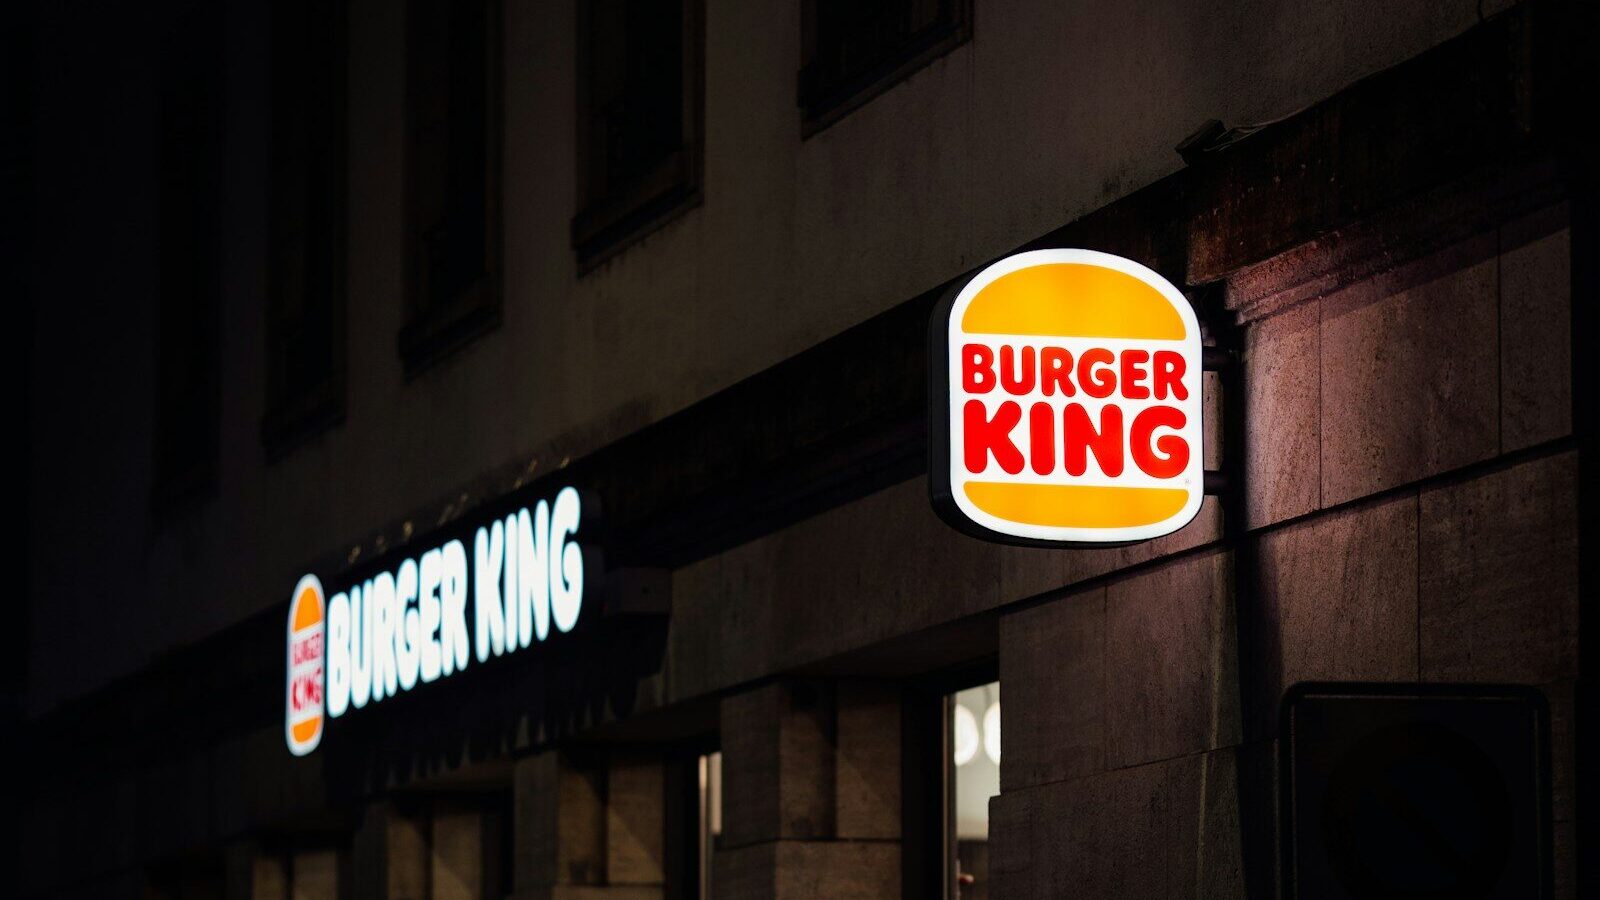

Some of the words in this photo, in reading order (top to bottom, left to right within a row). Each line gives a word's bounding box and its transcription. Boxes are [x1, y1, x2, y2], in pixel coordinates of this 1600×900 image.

[962, 343, 1188, 401] BURGER
[963, 399, 1190, 479] KING
[327, 539, 469, 717] BURGER
[474, 486, 583, 663] KING
